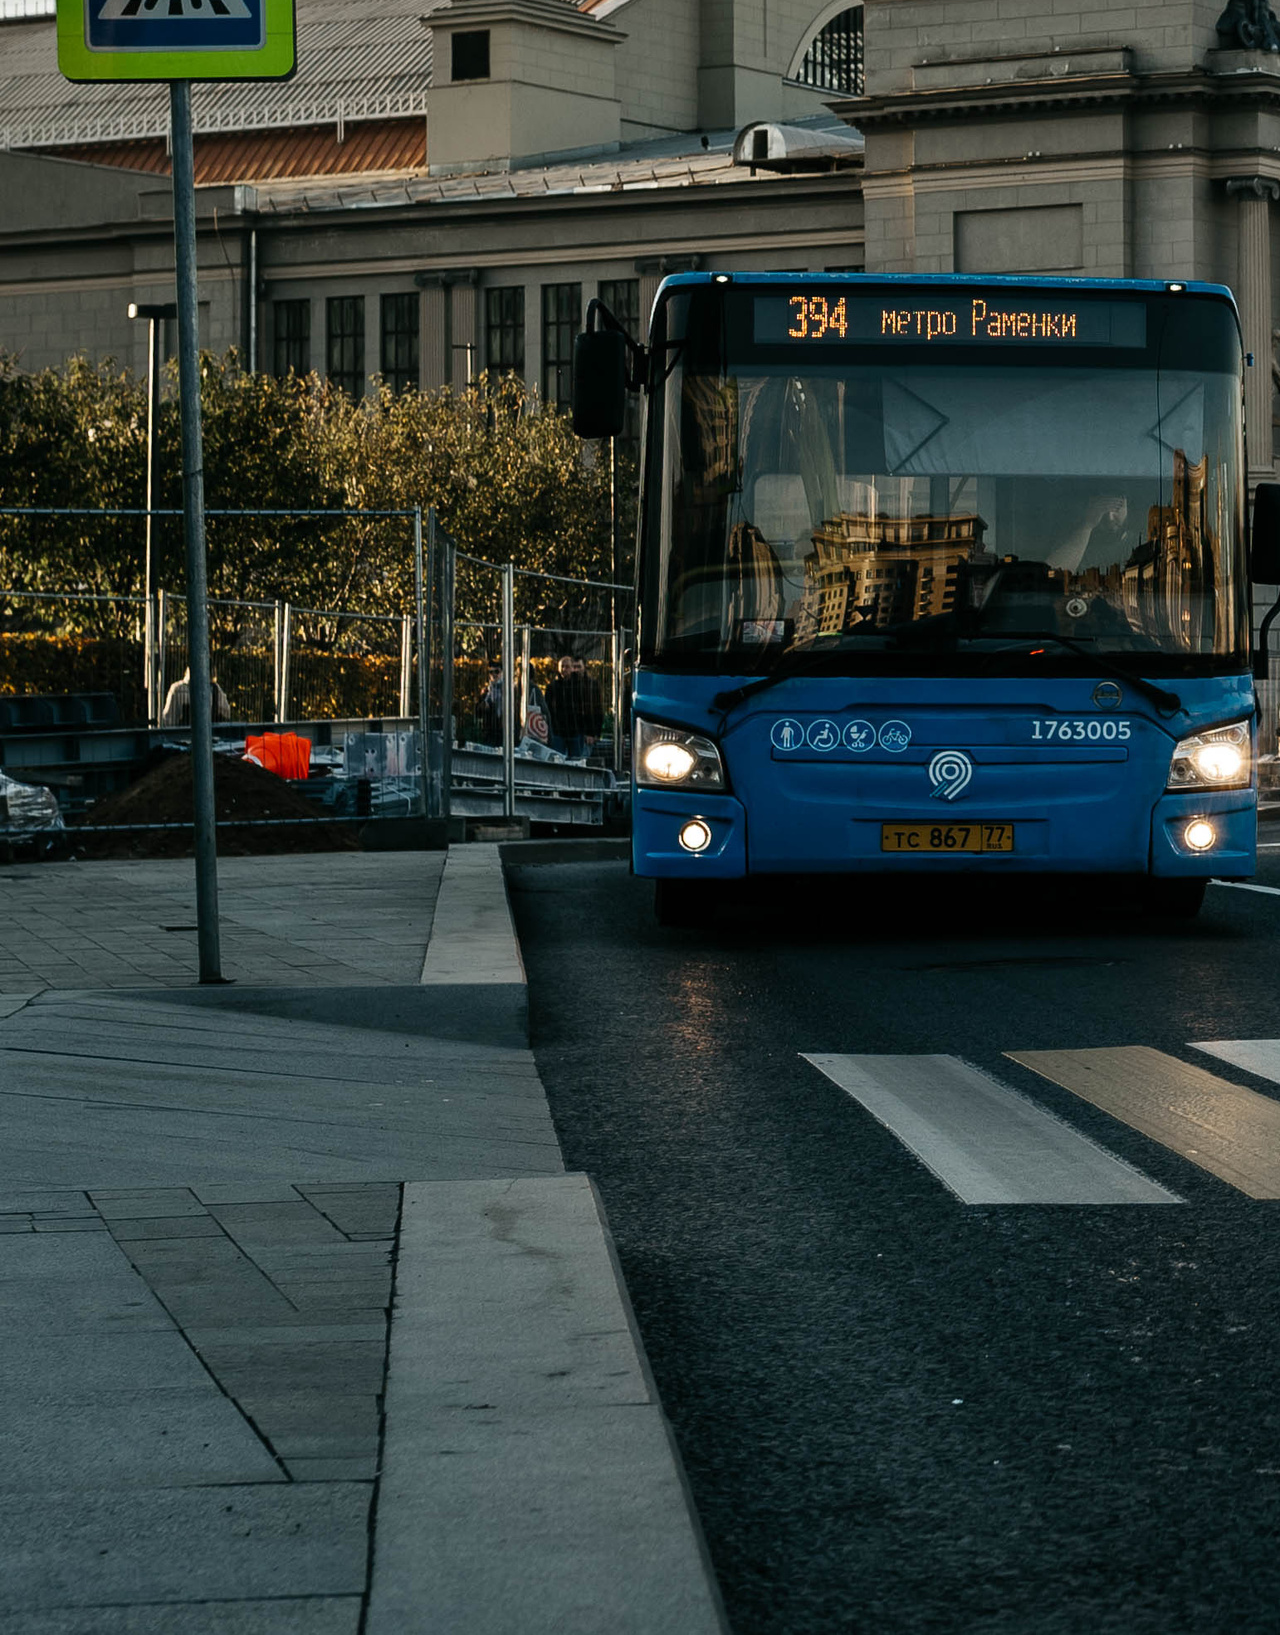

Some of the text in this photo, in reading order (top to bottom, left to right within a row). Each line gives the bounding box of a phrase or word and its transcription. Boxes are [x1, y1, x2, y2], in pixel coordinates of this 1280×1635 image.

[789, 296, 1077, 340] 394 метро Раменки
[1031, 720, 1131, 740] 1763005
[894, 826, 1006, 848] ТС 867 77
